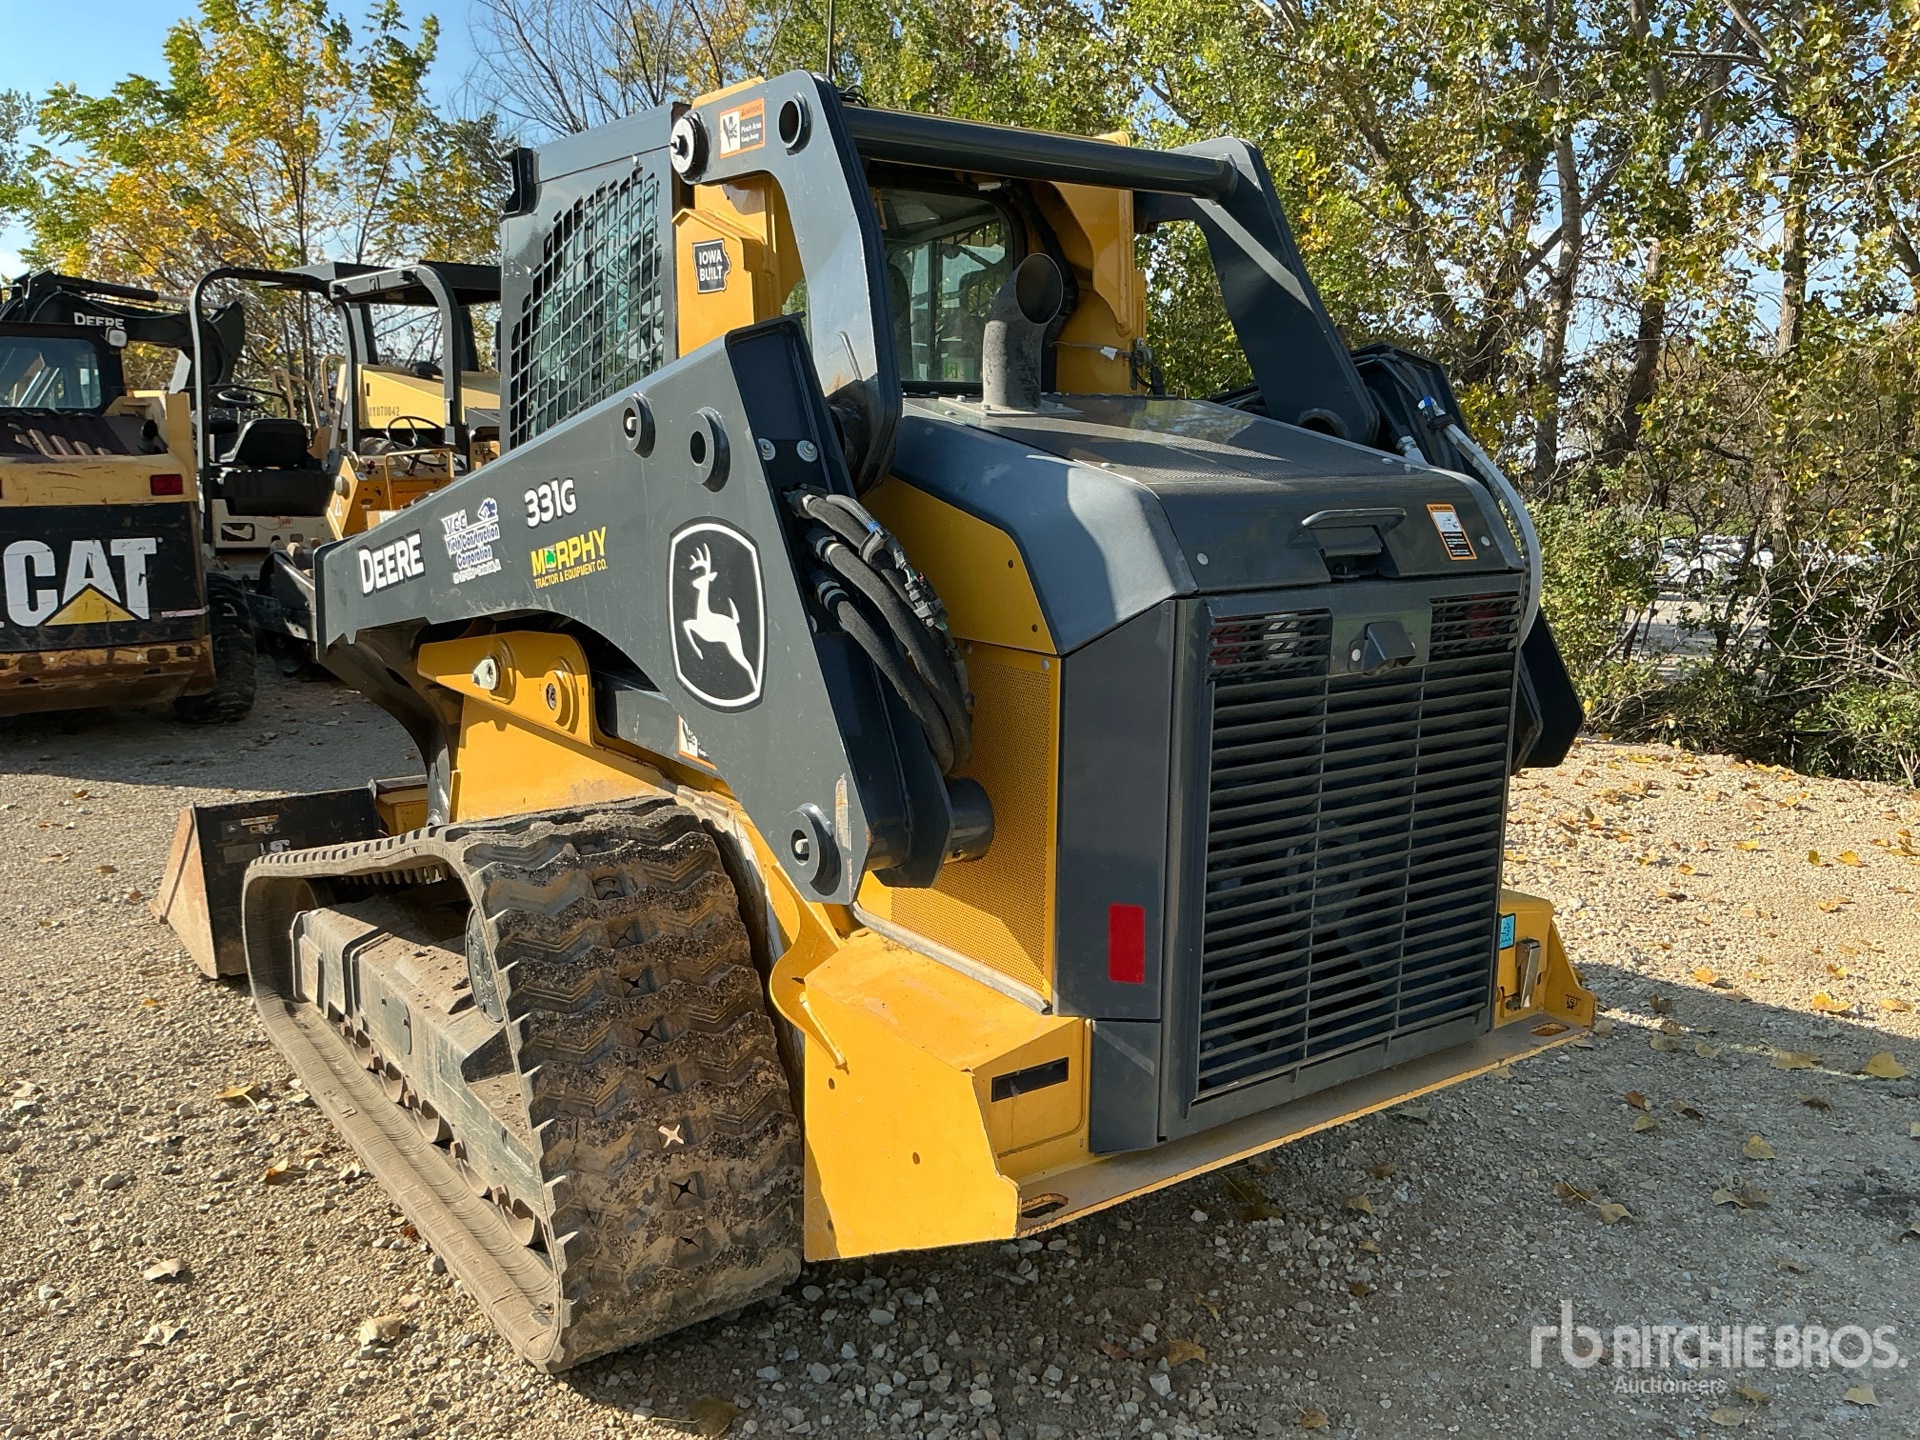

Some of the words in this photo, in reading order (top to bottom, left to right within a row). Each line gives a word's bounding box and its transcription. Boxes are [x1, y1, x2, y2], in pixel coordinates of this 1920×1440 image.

[699, 249, 723, 266] IOWA
[699, 265, 723, 282] BUILT
[73, 311, 126, 331] DEERE
[524, 479, 577, 528] 331G
[358, 533, 425, 594] DEERE
[534, 574, 559, 589] TRACTOR
[564, 561, 596, 581] EQUIPMENT
[596, 558, 608, 571] CO.
[3, 537, 157, 628] CAT
